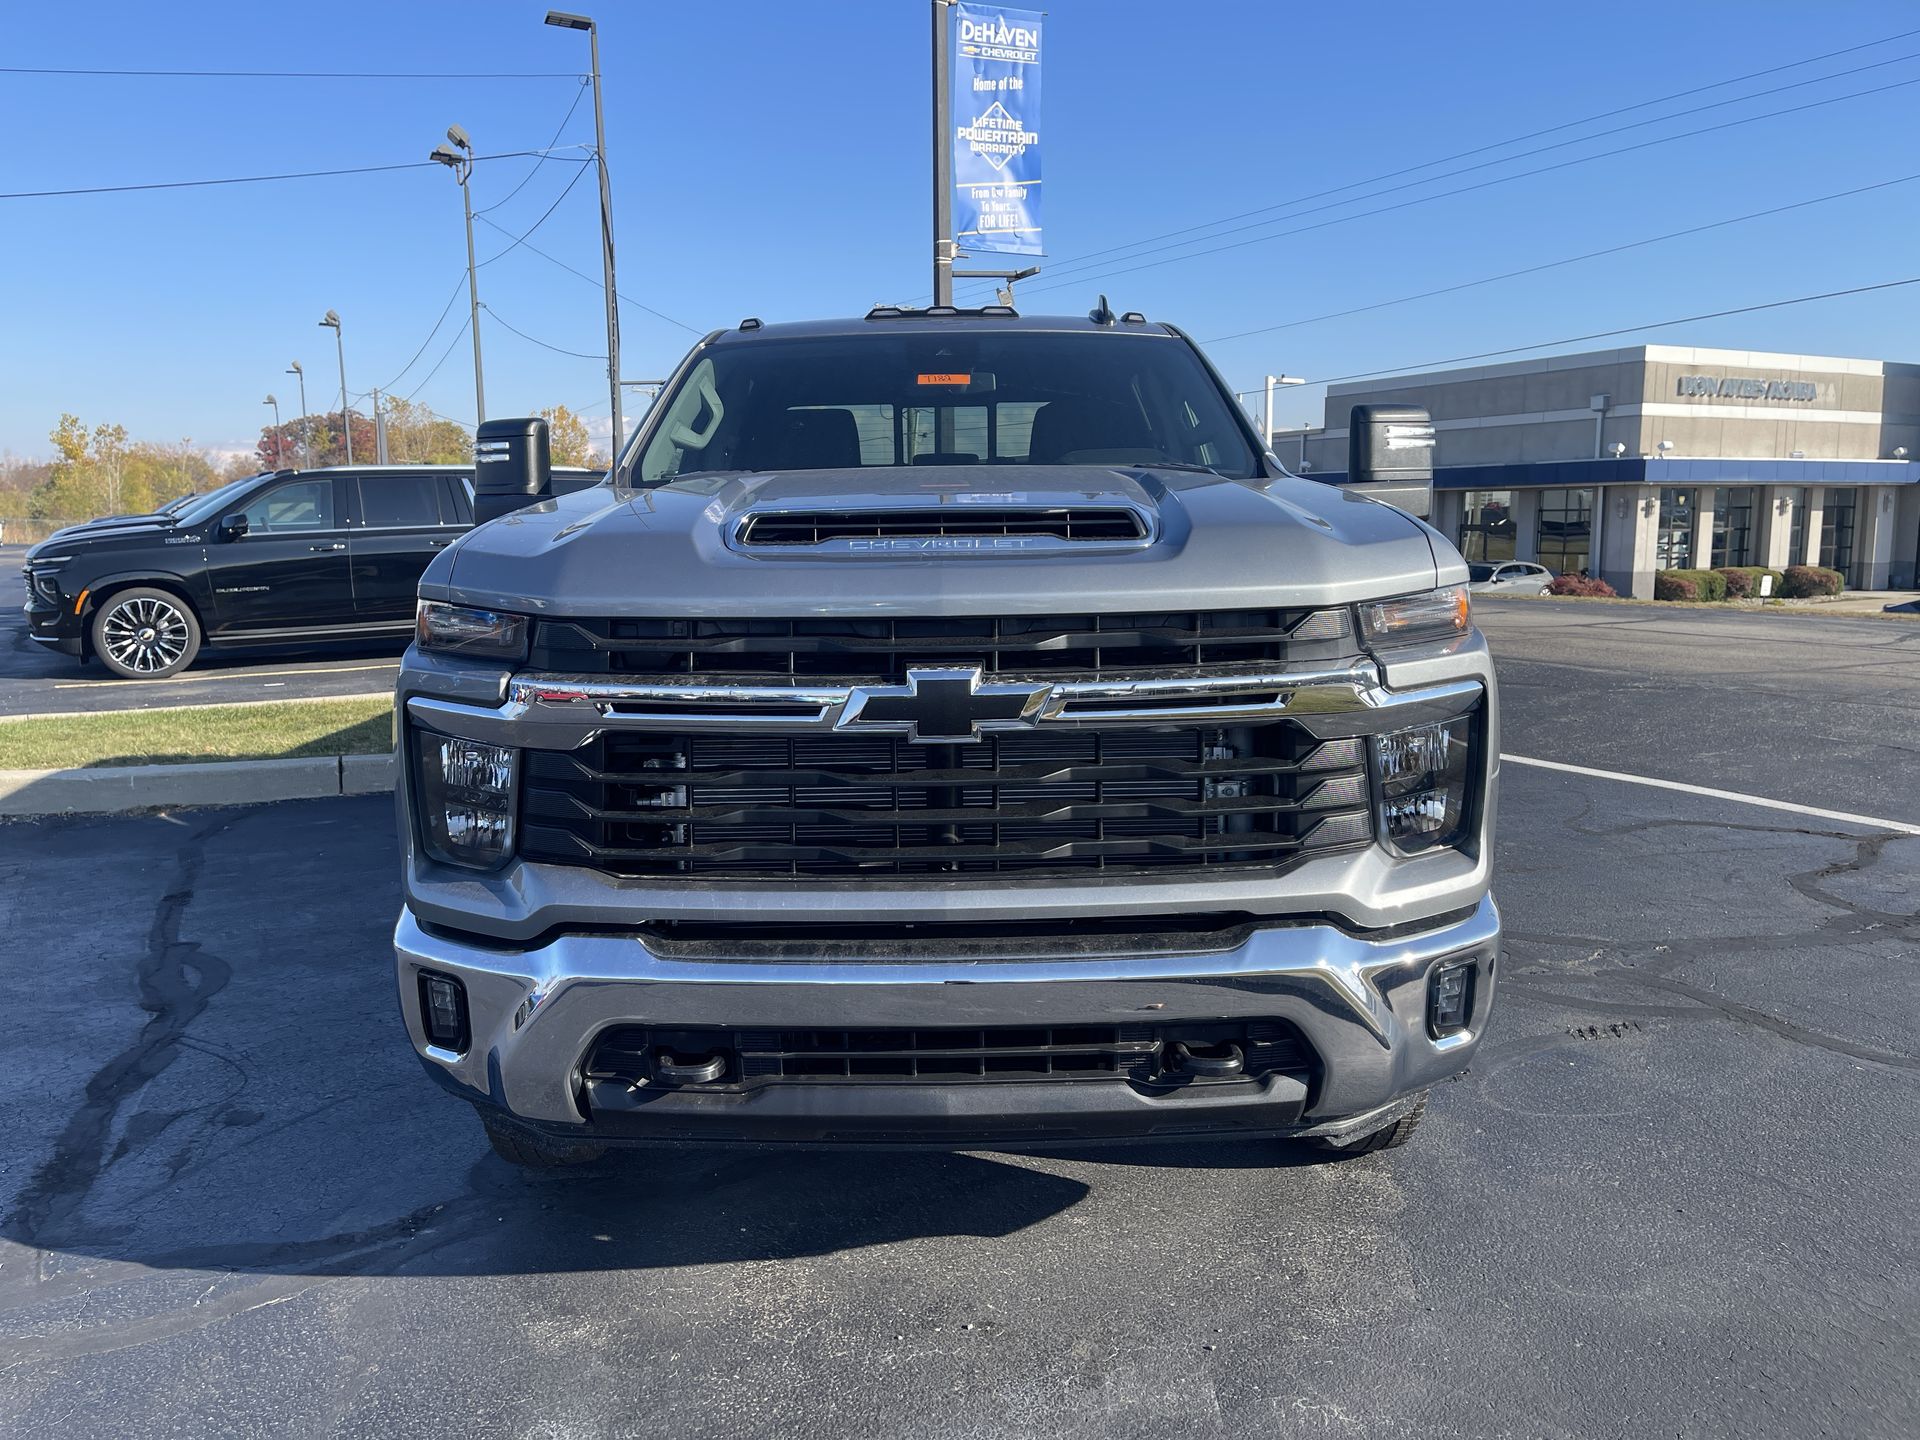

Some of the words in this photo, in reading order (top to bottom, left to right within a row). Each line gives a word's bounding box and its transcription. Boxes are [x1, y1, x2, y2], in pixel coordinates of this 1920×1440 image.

[981, 46, 1037, 61] CHEVROLET
[973, 77, 996, 91] Home
[998, 76, 1007, 90] of
[1009, 76, 1023, 90] the
[972, 117, 1023, 131] LIFETIME
[957, 127, 1039, 145] POWERTRAIN
[970, 141, 1026, 155] WARRANTY
[971, 187, 990, 199] From
[1005, 186, 1028, 200] Family
[981, 201, 990, 212] To
[980, 215, 996, 228] FOR
[998, 213, 1018, 228] LIFE!
[850, 540, 1033, 550] CHEVROLET
